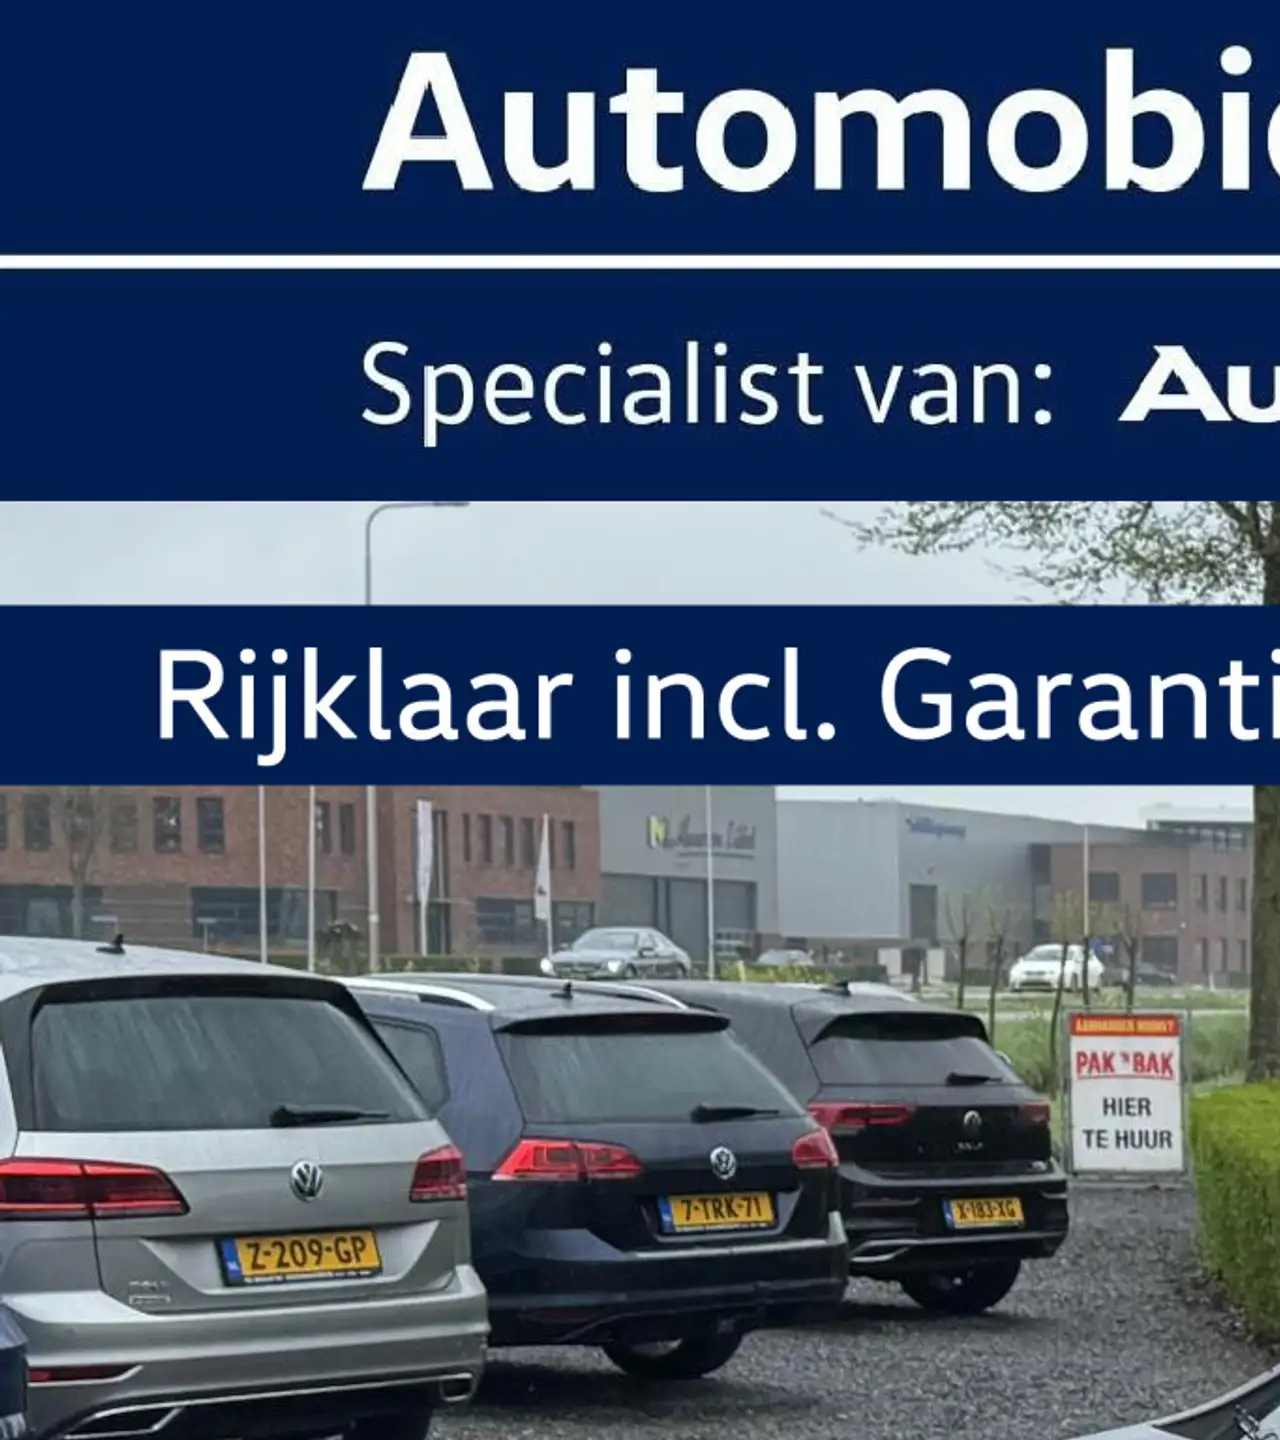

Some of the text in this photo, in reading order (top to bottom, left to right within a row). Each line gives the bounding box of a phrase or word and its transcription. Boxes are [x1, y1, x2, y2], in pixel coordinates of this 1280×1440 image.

[1076, 1051, 1115, 1075] PAK
[1133, 1051, 1173, 1076] BAK
[1103, 1097, 1152, 1117] HIER
[1082, 1129, 1173, 1149] TE HUUR
[681, 1195, 762, 1221] 7-TRK-71
[247, 1235, 367, 1271] Z-209-GP
